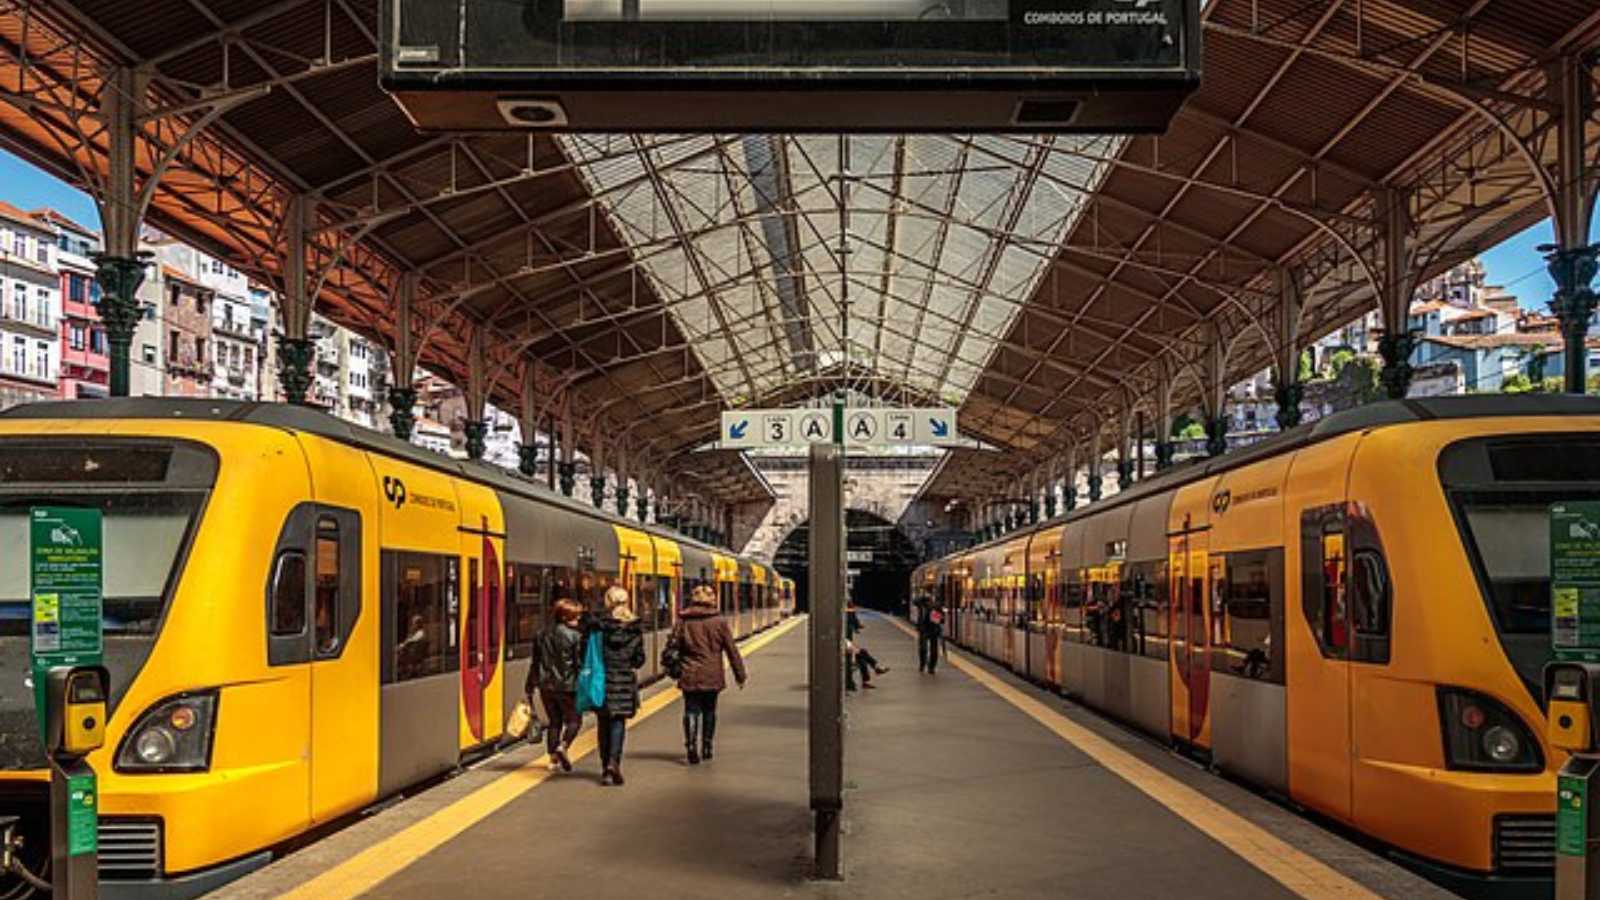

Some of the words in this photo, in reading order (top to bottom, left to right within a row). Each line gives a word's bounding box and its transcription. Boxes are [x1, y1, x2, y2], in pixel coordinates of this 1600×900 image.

[1087, 11, 1103, 24] DE
[1106, 11, 1168, 24] PORTUGAL
[772, 422, 783, 440] 3
[807, 420, 823, 437] A
[854, 419, 871, 437] A
[894, 423, 906, 440] 4
